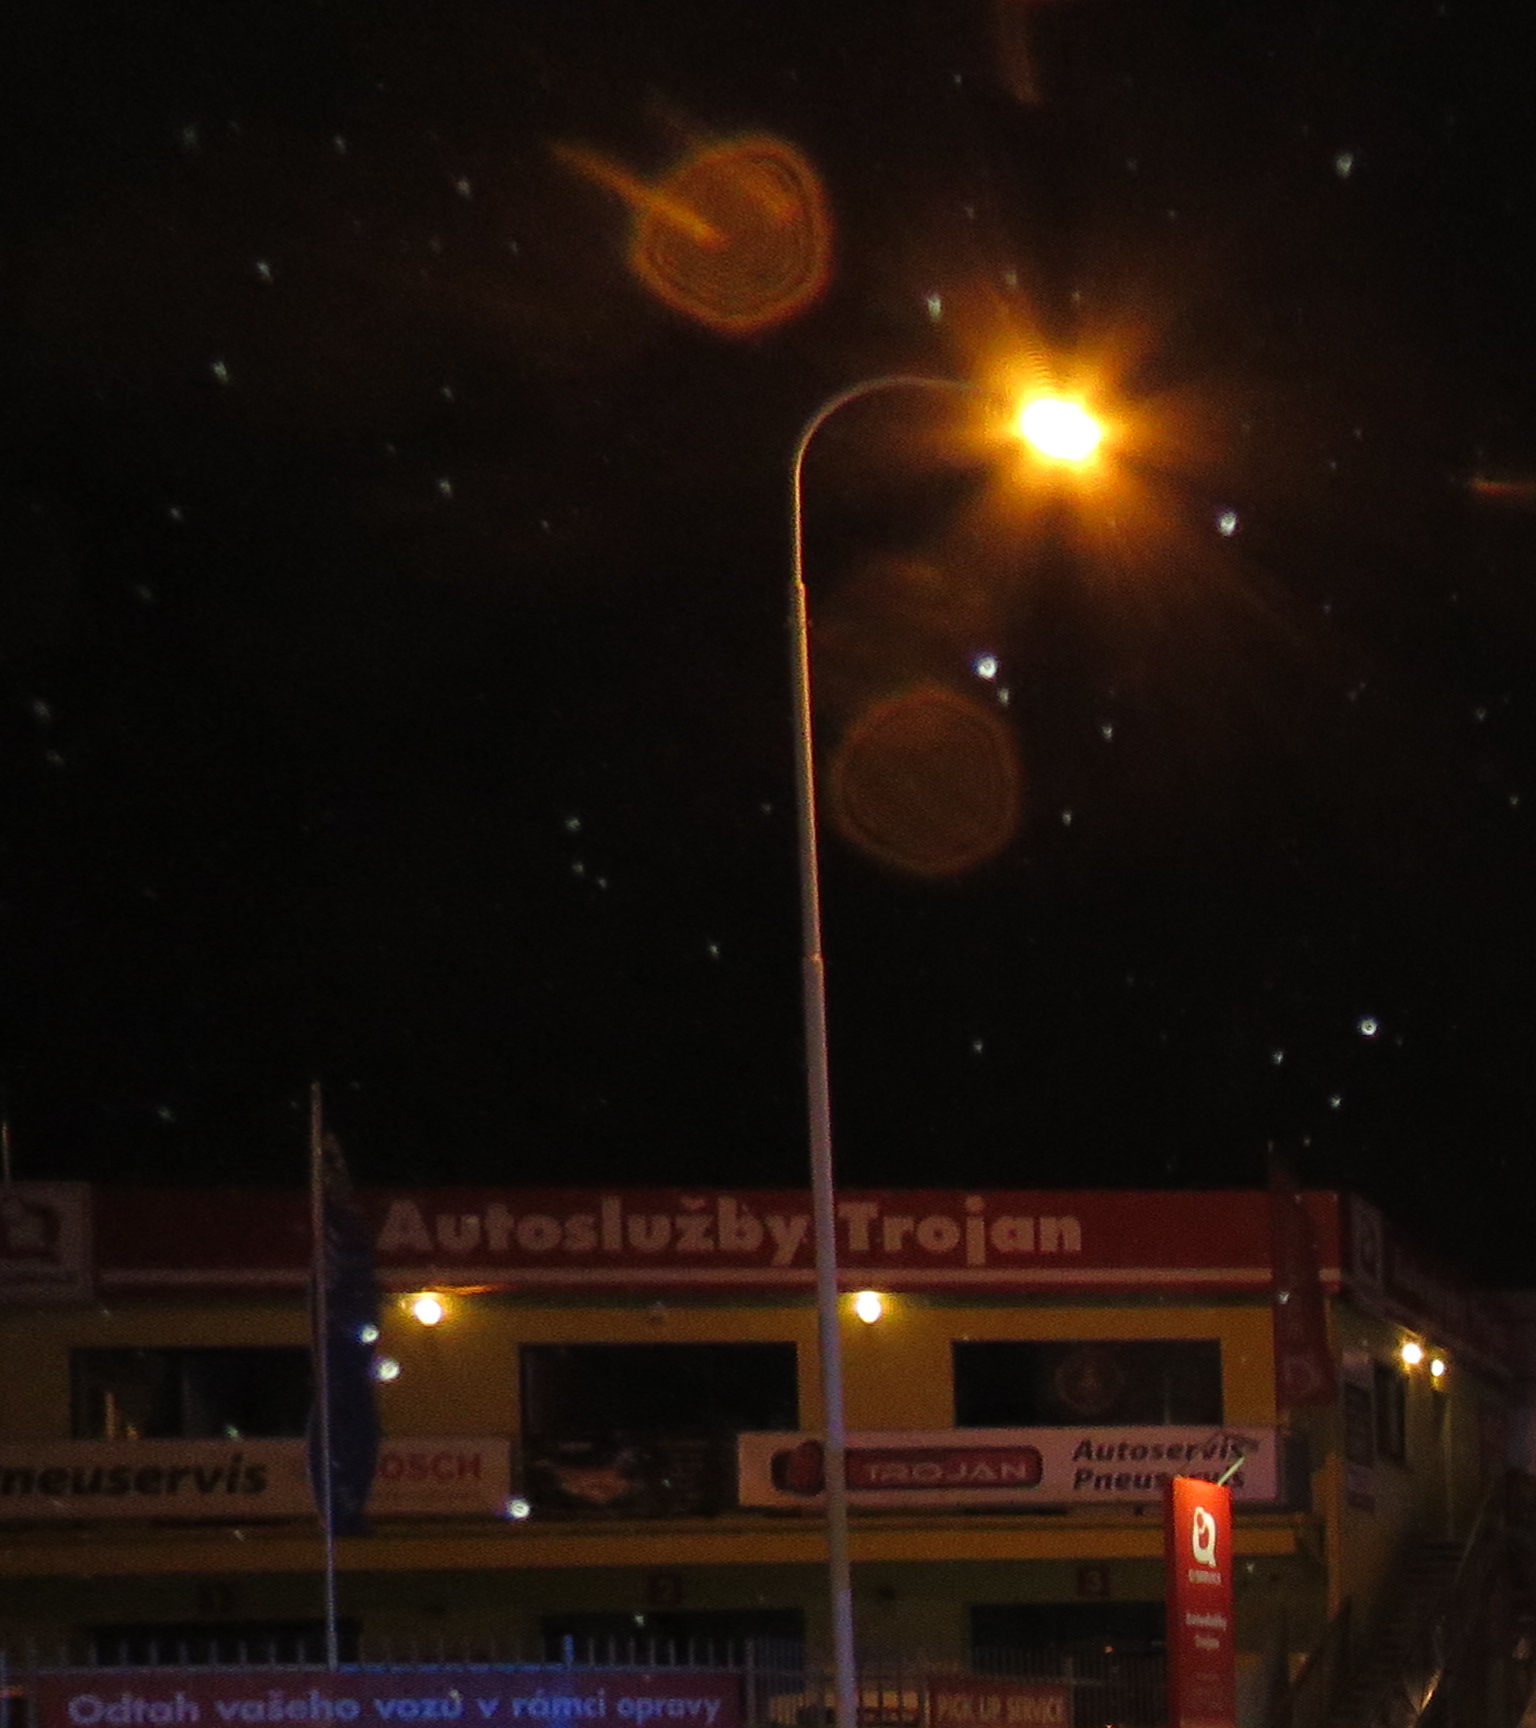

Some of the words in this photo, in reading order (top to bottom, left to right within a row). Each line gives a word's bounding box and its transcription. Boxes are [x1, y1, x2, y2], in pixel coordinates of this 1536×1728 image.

[378, 1195, 811, 1266] Autoslužby
[836, 1194, 1082, 1266] Trojan
[1072, 1439, 1244, 1461] Autoservis
[379, 1453, 481, 1481] OSCH
[861, 1461, 1027, 1482] TROJAN
[67, 1691, 200, 1725] Odtah
[213, 1688, 362, 1721] vašeho
[475, 1699, 501, 1718] v
[511, 1688, 607, 1718] rámci
[616, 1697, 722, 1725] opravy
